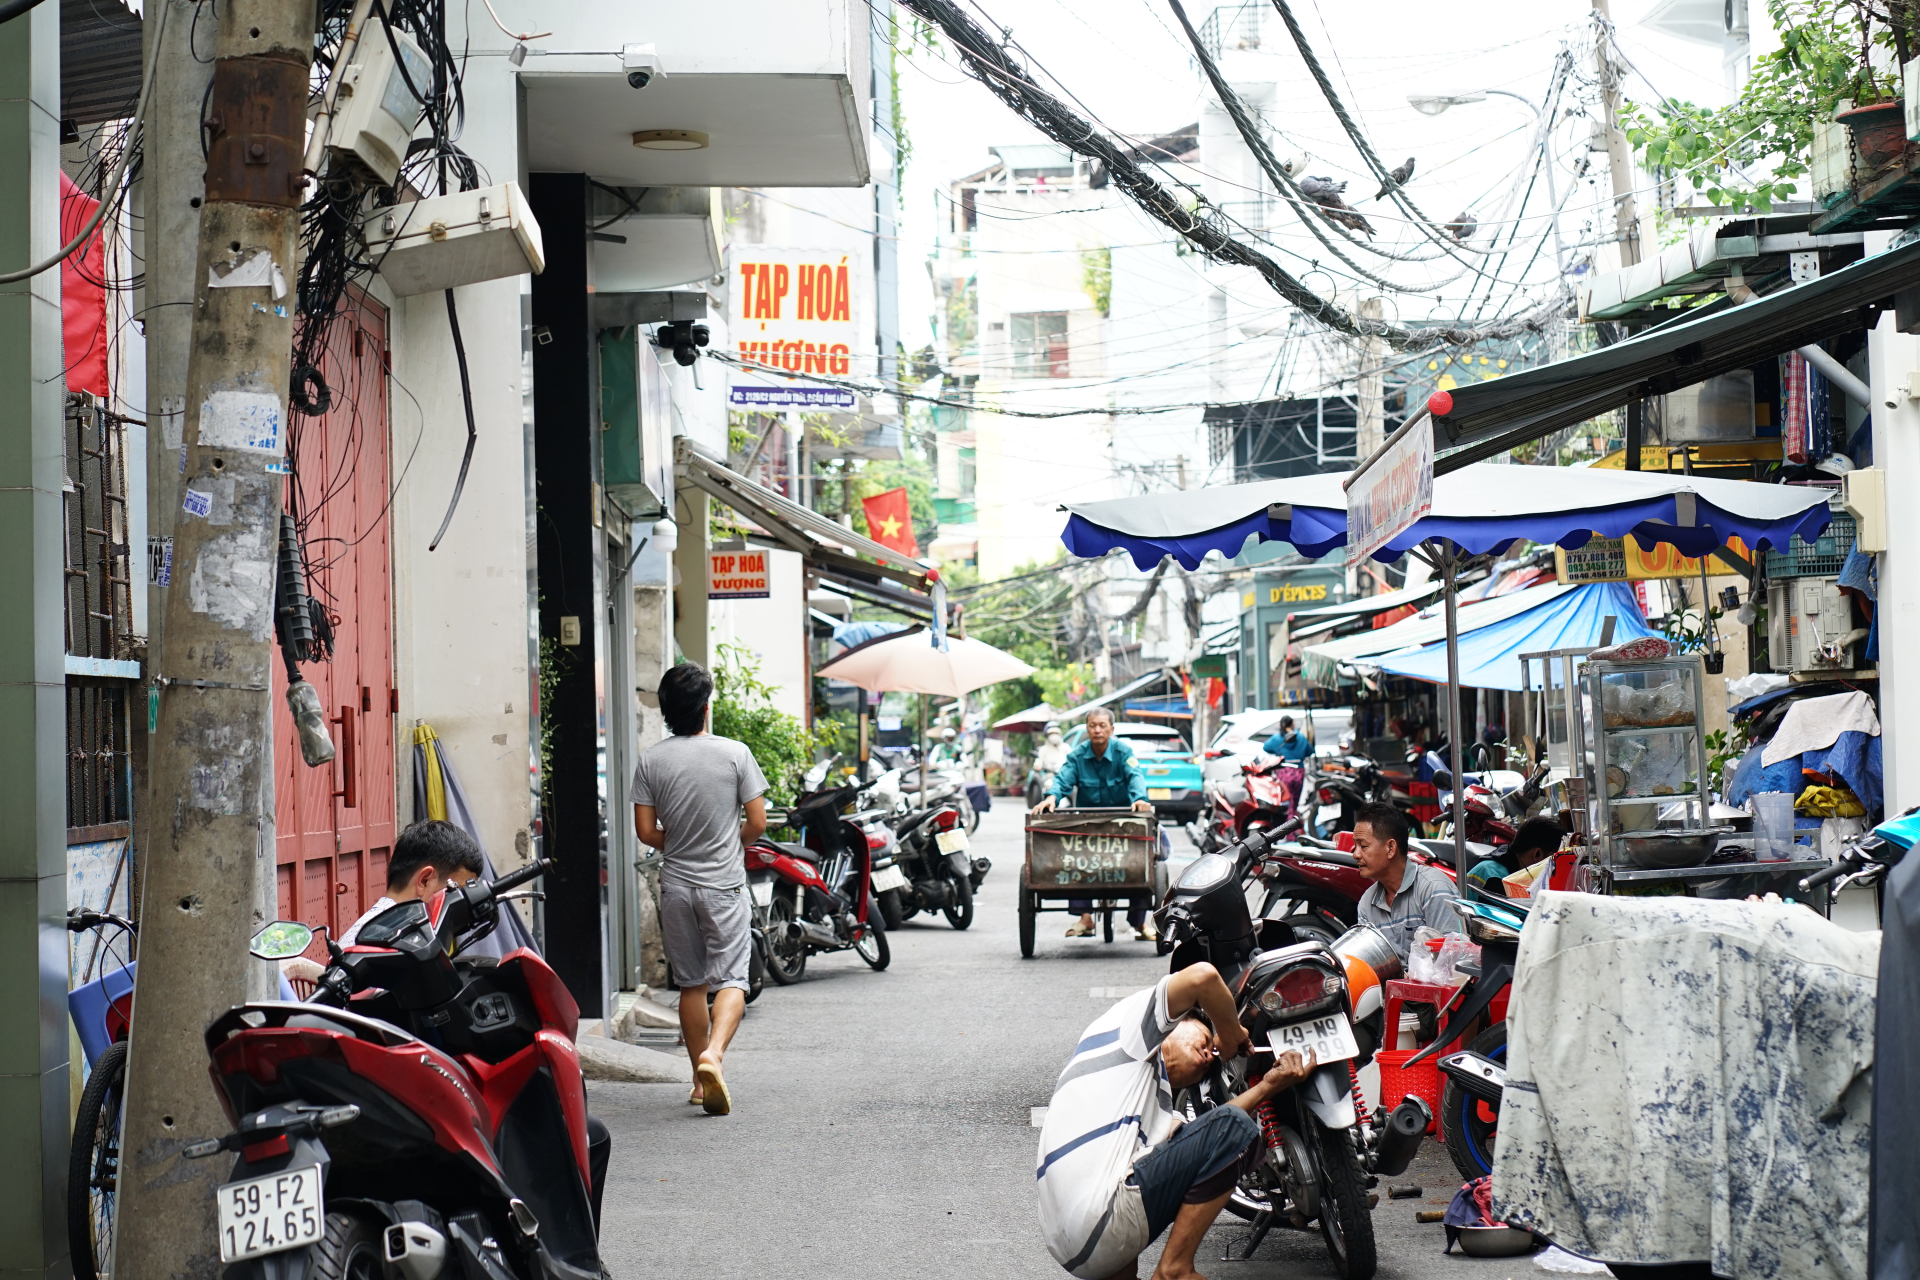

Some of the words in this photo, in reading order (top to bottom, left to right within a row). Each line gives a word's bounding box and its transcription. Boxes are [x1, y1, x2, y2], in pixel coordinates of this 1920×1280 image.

[741, 263, 789, 331] TẠP
[797, 256, 851, 321] HOÁ
[739, 339, 849, 380] VƯỢNG
[1608, 539, 1622, 549] NAM
[711, 556, 735, 577] TẠP
[739, 551, 765, 573] HOÁ
[1608, 560, 1625, 570] 277
[1608, 570, 1625, 578] 277
[712, 577, 765, 591] VƯỢNG
[1283, 1018, 1339, 1046] 49-N9
[233, 1174, 304, 1218] 59-F2
[226, 1206, 316, 1257] 124.65
